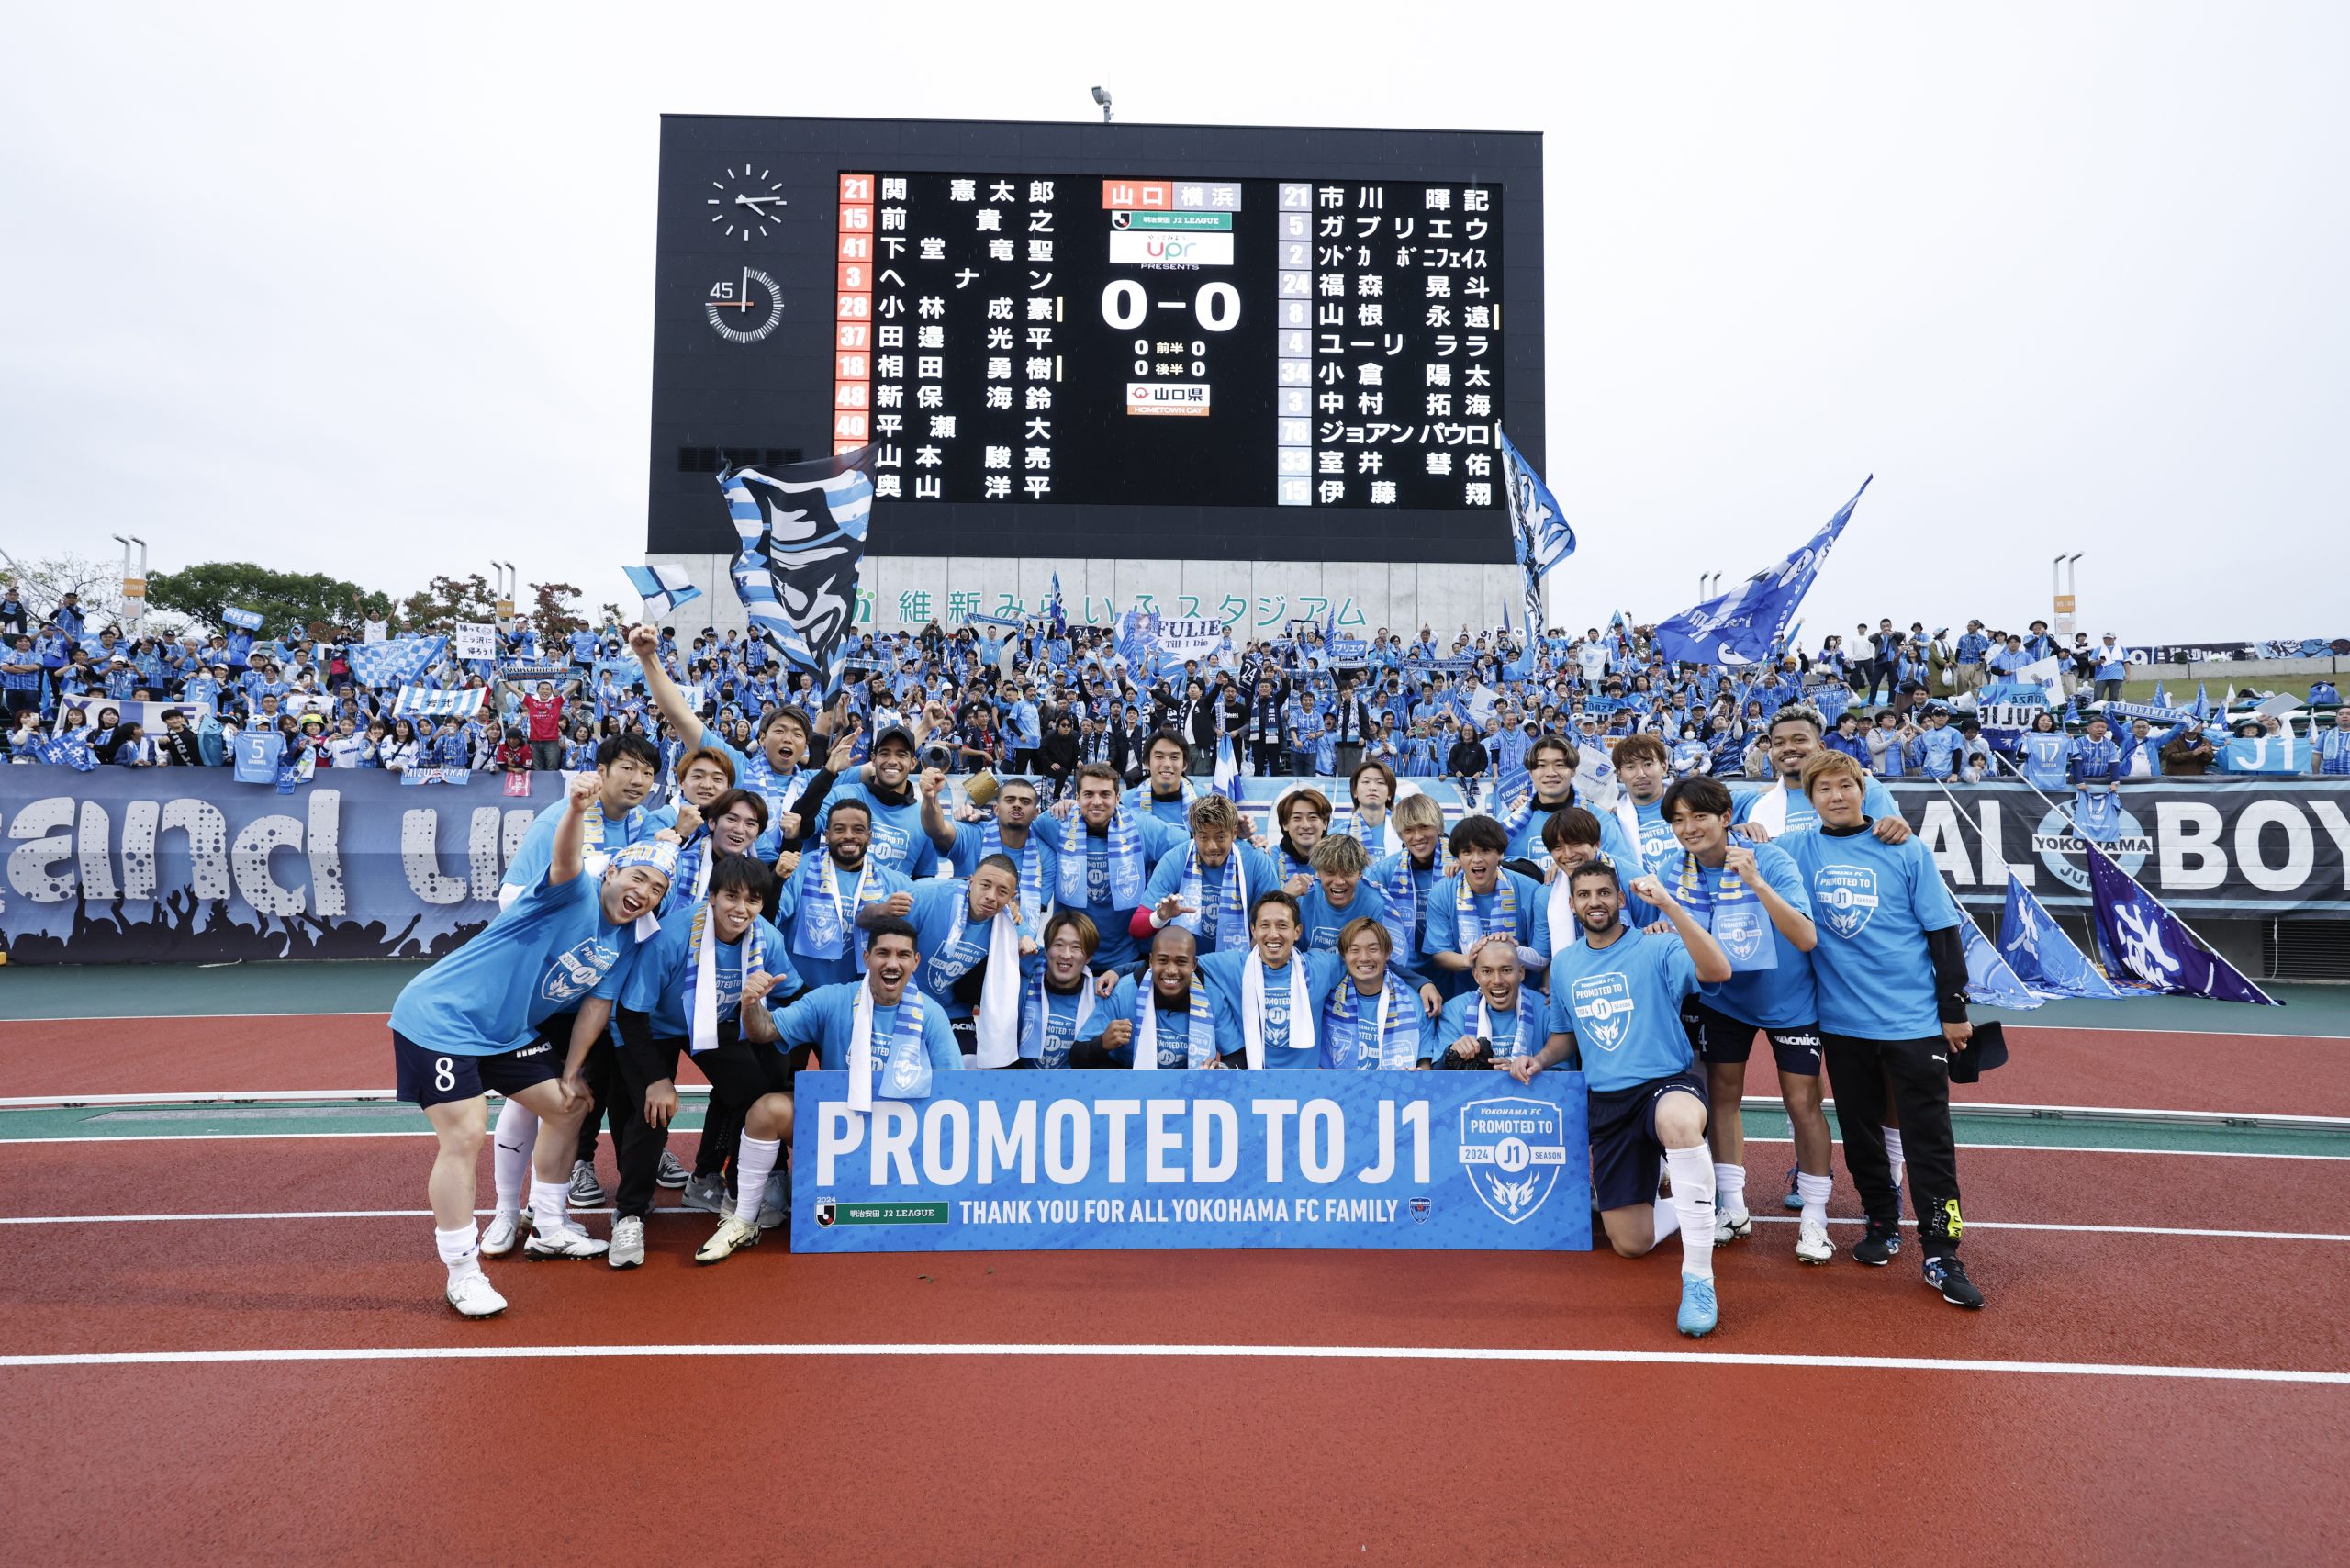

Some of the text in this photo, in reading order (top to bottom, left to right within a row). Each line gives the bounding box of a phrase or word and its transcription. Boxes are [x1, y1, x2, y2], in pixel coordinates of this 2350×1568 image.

[845, 177, 1054, 203] 21 関 憲太郎
[1113, 185, 1234, 207] 山口 横浜
[1285, 187, 1307, 206] 21
[1319, 186, 1382, 208] 市川
[843, 207, 1054, 231] 15 前 貴之
[1290, 216, 1487, 240] 5 ガブリエウ
[843, 237, 1053, 261] 41 下堂 竜聖
[1147, 242, 1196, 260] upr
[1290, 245, 1303, 263] 2
[846, 267, 861, 287] 3
[1283, 274, 1489, 298] 24 福森 晃斗
[710, 282, 733, 298] 45
[840, 297, 867, 317] 28
[879, 296, 945, 319] 小林
[1289, 303, 1489, 328] 8 山根 永遠
[841, 326, 866, 346] 37
[988, 327, 1052, 350] 光平
[1135, 340, 1205, 356] 0 前半 0
[1289, 333, 1488, 356] 4 ユーリ ララ
[840, 355, 1052, 380] 18 相田 勇樹
[1135, 360, 1205, 376] 0 後半 0
[1282, 362, 1490, 386] 34 小倉 陽太
[837, 385, 1051, 409] 48 新保 海鈴
[1155, 387, 1203, 401] 山口県
[1289, 391, 1490, 416] 3 中村 拓海
[836, 415, 1050, 439] 40 平瀬 大
[1283, 421, 1488, 445] 78 ジョアン パウロ
[877, 444, 942, 467] 山本
[985, 446, 1050, 469] 駿亮
[1319, 451, 1382, 474] 室井
[875, 475, 1050, 499] 奥山 洋平
[1282, 480, 1491, 505] 15 伊藤 翔
[1158, 619, 1222, 638] FULIE
[1480, 630, 1492, 640] J1
[1165, 640, 1181, 648] Till
[1241, 663, 1257, 679] 24
[2113, 700, 2183, 720] YOKOHAMA FC
[252, 739, 265, 759] 5
[2038, 743, 2059, 763] 17
[2236, 738, 2294, 771] J1
[896, 836, 905, 846] TO
[1651, 842, 1660, 852] J1
[1909, 800, 2035, 886] AL
[2034, 836, 2151, 852] YOKOAMA
[0, 790, 346, 916] and
[878, 847, 889, 856] J1
[1091, 873, 1101, 881] J1
[1820, 877, 1871, 888] PROMOTED TO
[1837, 892, 1847, 903] J1
[949, 965, 960, 974] J1
[1576, 984, 1623, 999] PROMOTED TO
[1272, 1010, 1281, 1019] J1
[1596, 1003, 1607, 1015] J1
[1046, 1039, 1057, 1047] J1
[1160, 1053, 1171, 1062] J1
[435, 1058, 455, 1092] 8
[1471, 1120, 1553, 1134] PROMOTED TO
[817, 1099, 1429, 1186] PROMOTED TO J1
[1465, 1146, 1561, 1164] 2024 J1 SEASON
[895, 1209, 934, 1217] LEAGUE
[960, 1199, 1398, 1224] THANK YOU FOR ALL YOKOHAMA FC FAMILY
